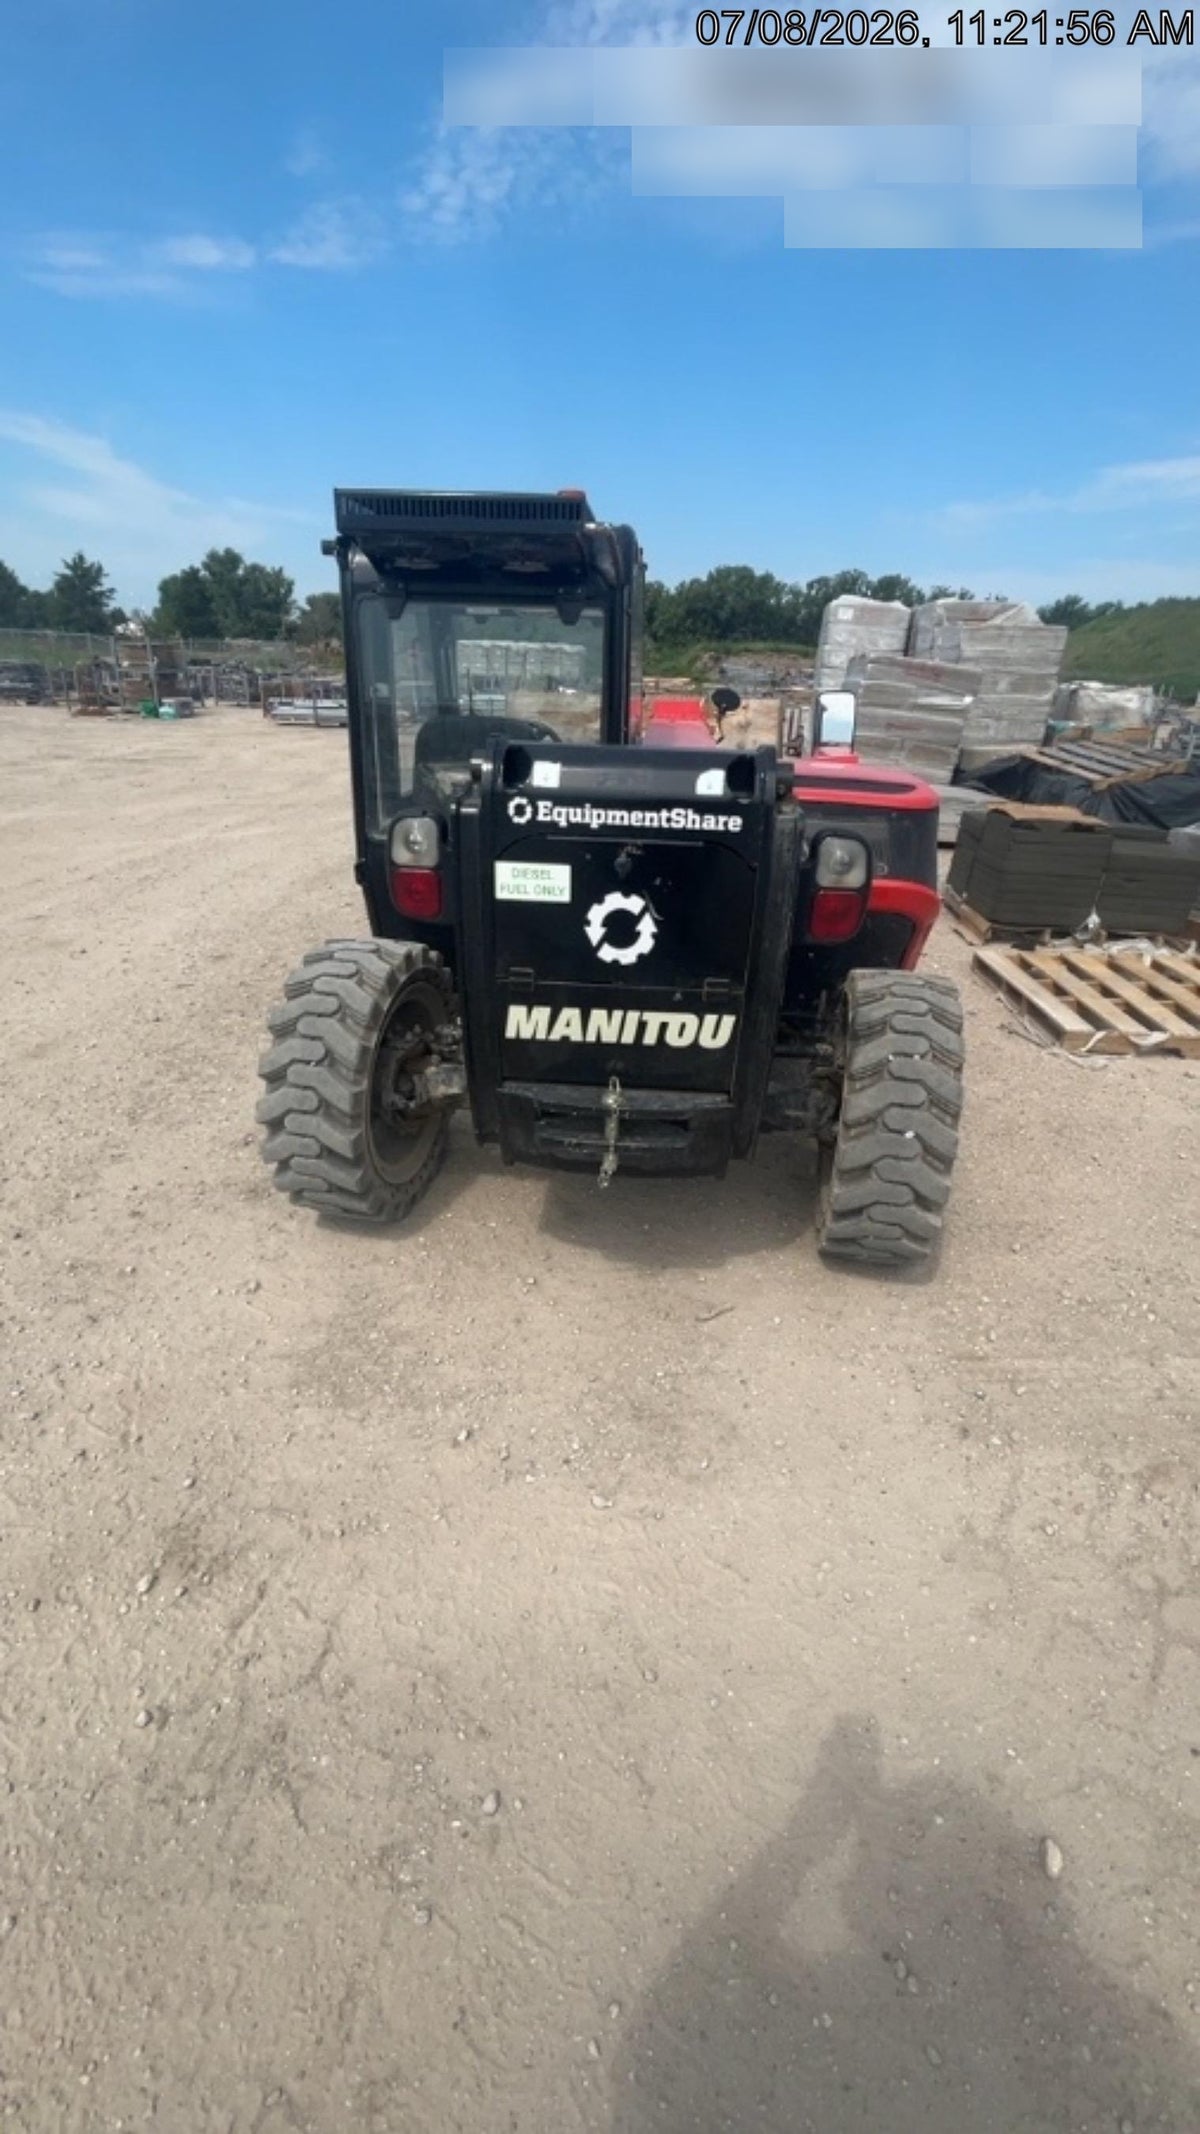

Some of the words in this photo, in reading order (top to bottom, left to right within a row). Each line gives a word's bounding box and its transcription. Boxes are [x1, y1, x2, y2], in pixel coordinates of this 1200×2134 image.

[536, 801, 743, 832] EquipmentShare
[511, 867, 554, 880] DIESEL
[500, 882, 529, 895] FUEL
[533, 884, 566, 897] ONLY
[505, 1004, 737, 1049] MANITOU
